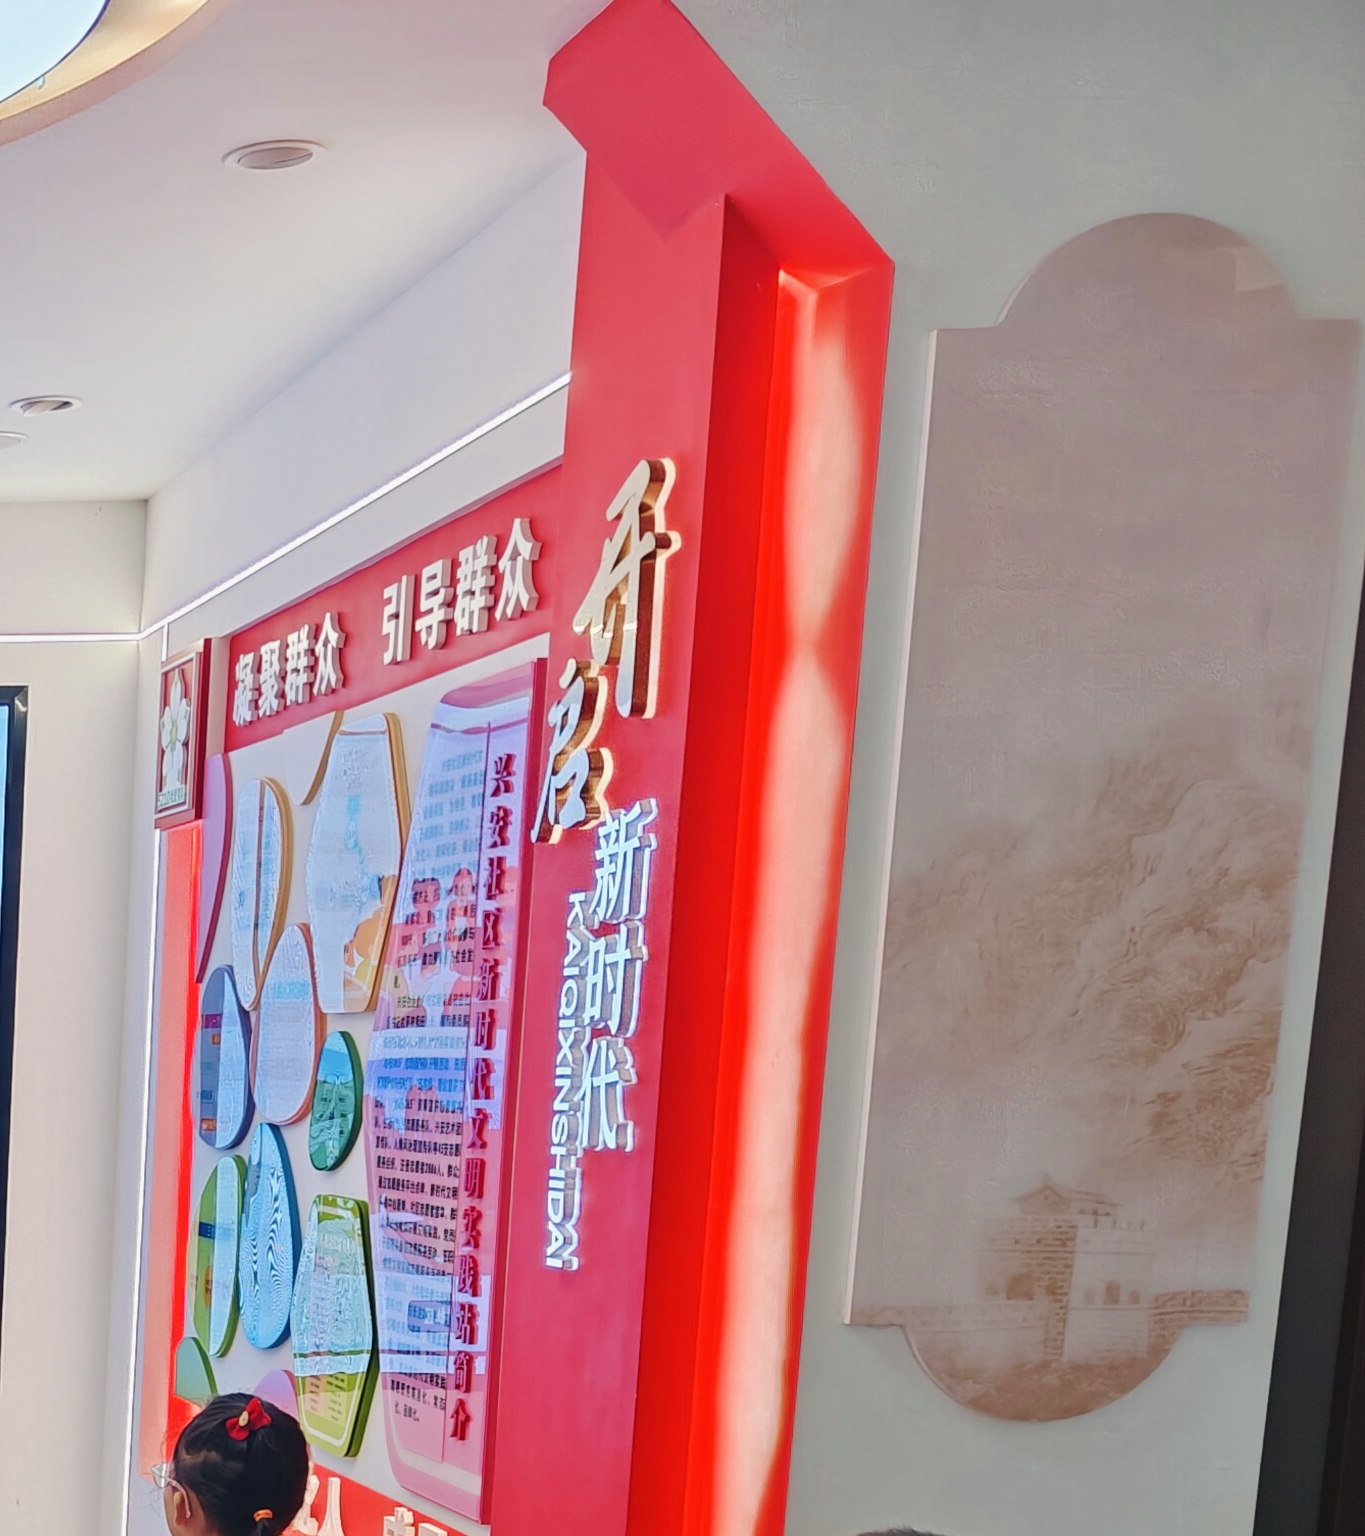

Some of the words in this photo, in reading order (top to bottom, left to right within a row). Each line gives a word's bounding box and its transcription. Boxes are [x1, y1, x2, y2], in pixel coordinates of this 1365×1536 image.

[232, 611, 347, 728] 凝聚群众
[381, 517, 543, 666] 引导群众
[450, 753, 517, 1441] 兴安社区新时代文明实践站简介
[573, 798, 658, 1153] 新时代
